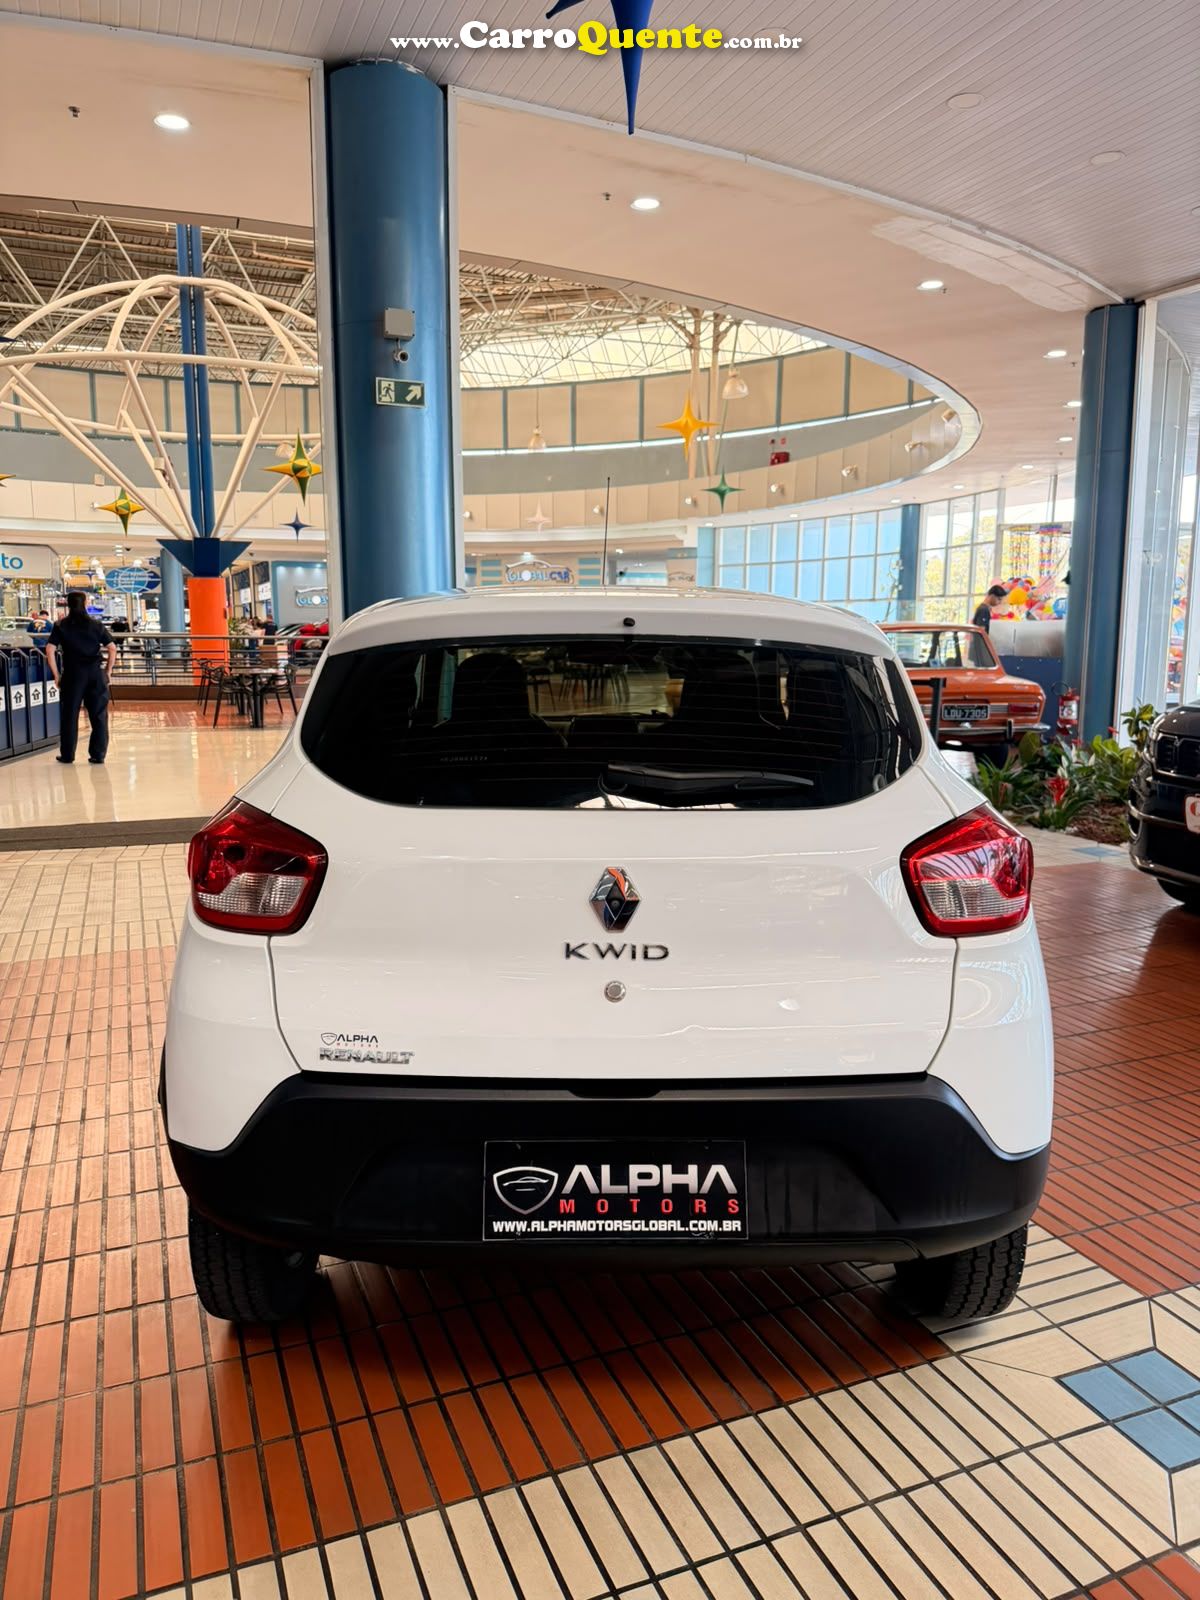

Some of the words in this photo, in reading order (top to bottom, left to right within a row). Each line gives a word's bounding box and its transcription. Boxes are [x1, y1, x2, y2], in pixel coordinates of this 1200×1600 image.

[564, 942, 670, 961] KWID
[336, 1034, 379, 1043] ALPHA
[319, 1048, 415, 1064] RENAULT
[561, 1164, 738, 1194] ALPHA
[559, 1199, 740, 1214] MOTORS
[492, 1219, 742, 1232] WWW.ALPHAMOTORSGLOBAL.COM.BR
